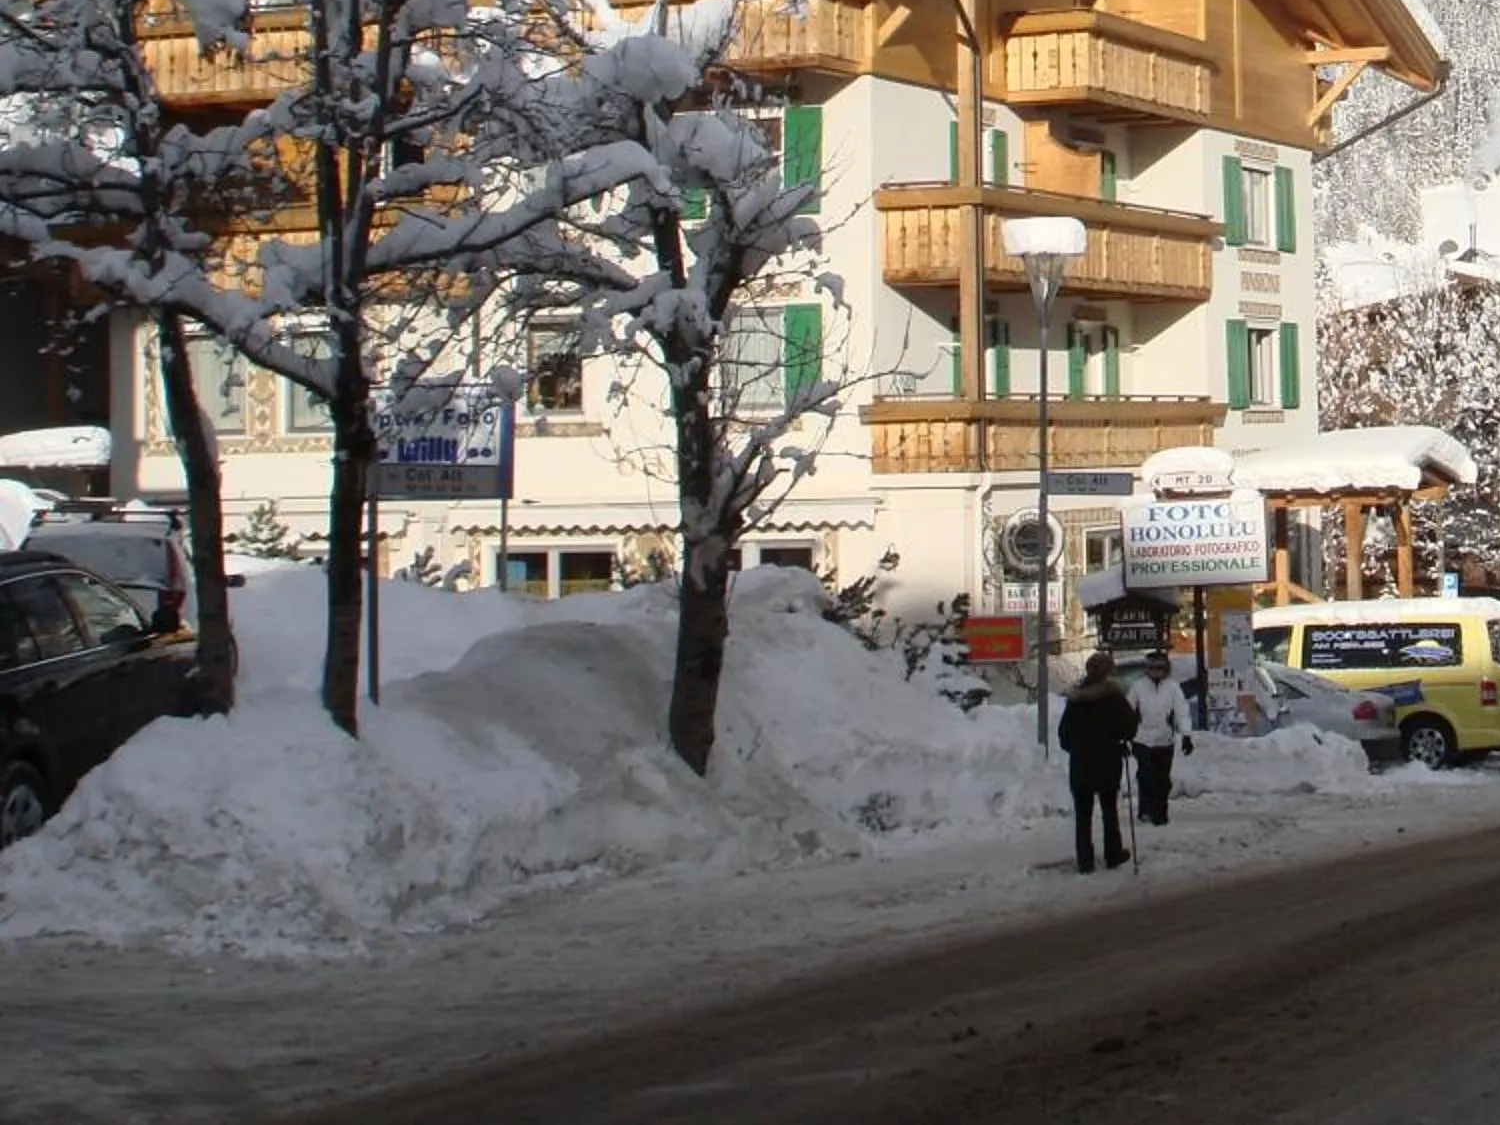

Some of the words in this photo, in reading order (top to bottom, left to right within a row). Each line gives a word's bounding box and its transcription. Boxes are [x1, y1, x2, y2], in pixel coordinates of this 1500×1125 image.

[443, 408, 496, 426] Foto
[1129, 522, 1257, 542] HONOLULU
[1129, 543, 1191, 558] LABORATORIO
[1195, 541, 1260, 556] FOTOGRAFICO
[1129, 557, 1261, 575] PROFESSIONALE
